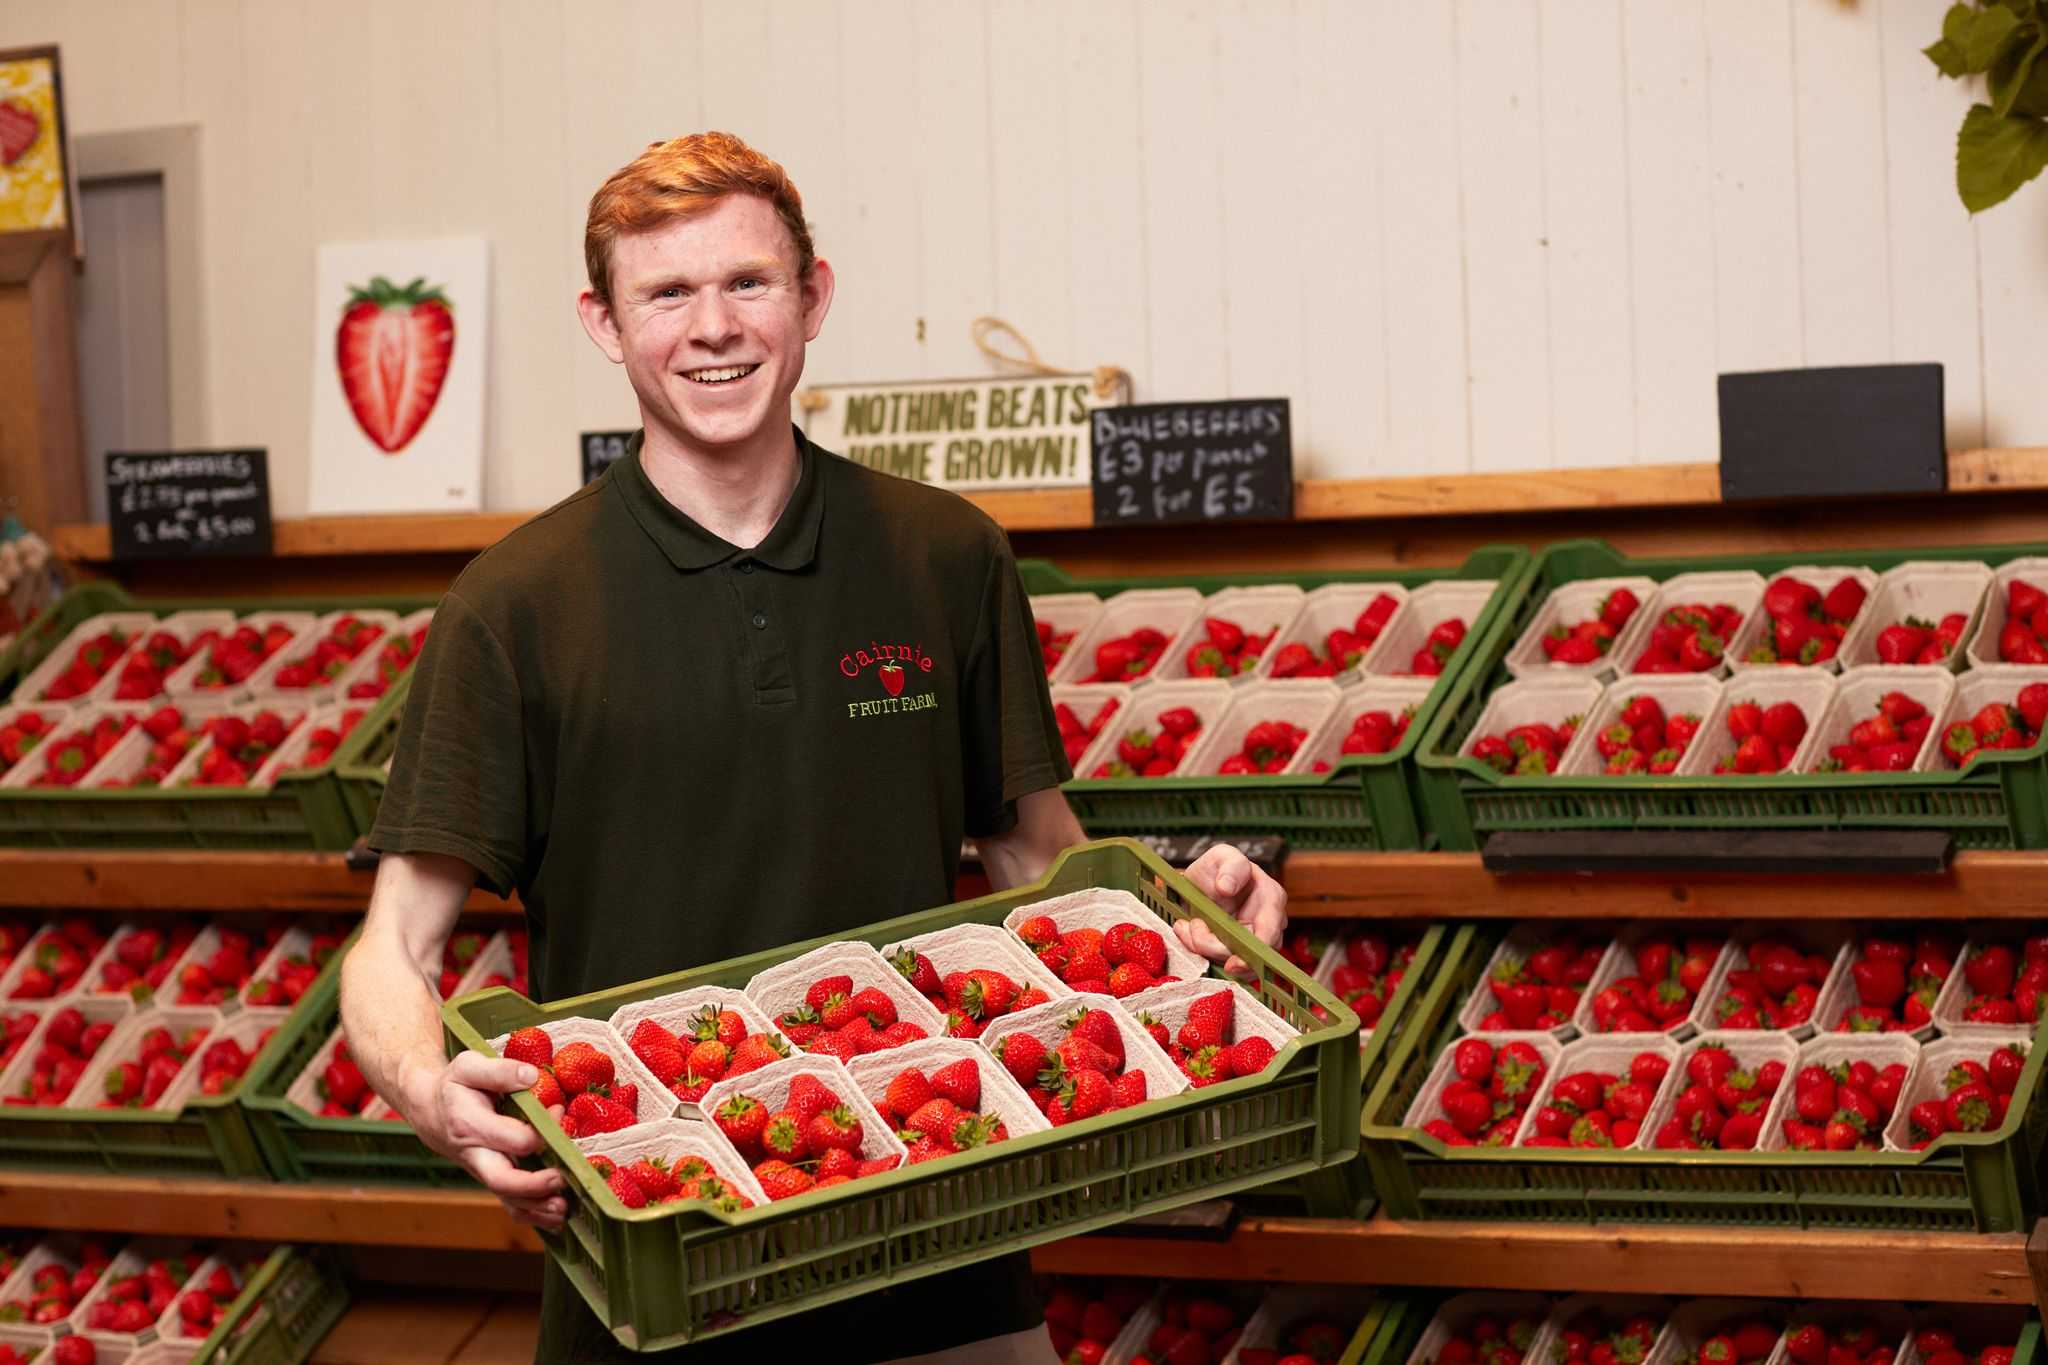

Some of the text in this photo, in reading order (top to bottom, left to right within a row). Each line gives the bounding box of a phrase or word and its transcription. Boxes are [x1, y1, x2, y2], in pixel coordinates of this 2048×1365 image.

[843, 384, 1089, 437] NOTHING BEATS
[1094, 407, 1281, 445] BLUEBERRIES
[945, 436, 1077, 481] GROWN!
[1117, 485, 1140, 517] 2
[1152, 484, 1192, 519] for
[840, 641, 933, 677] Cairnie
[848, 692, 938, 718] FRUIT FARM
